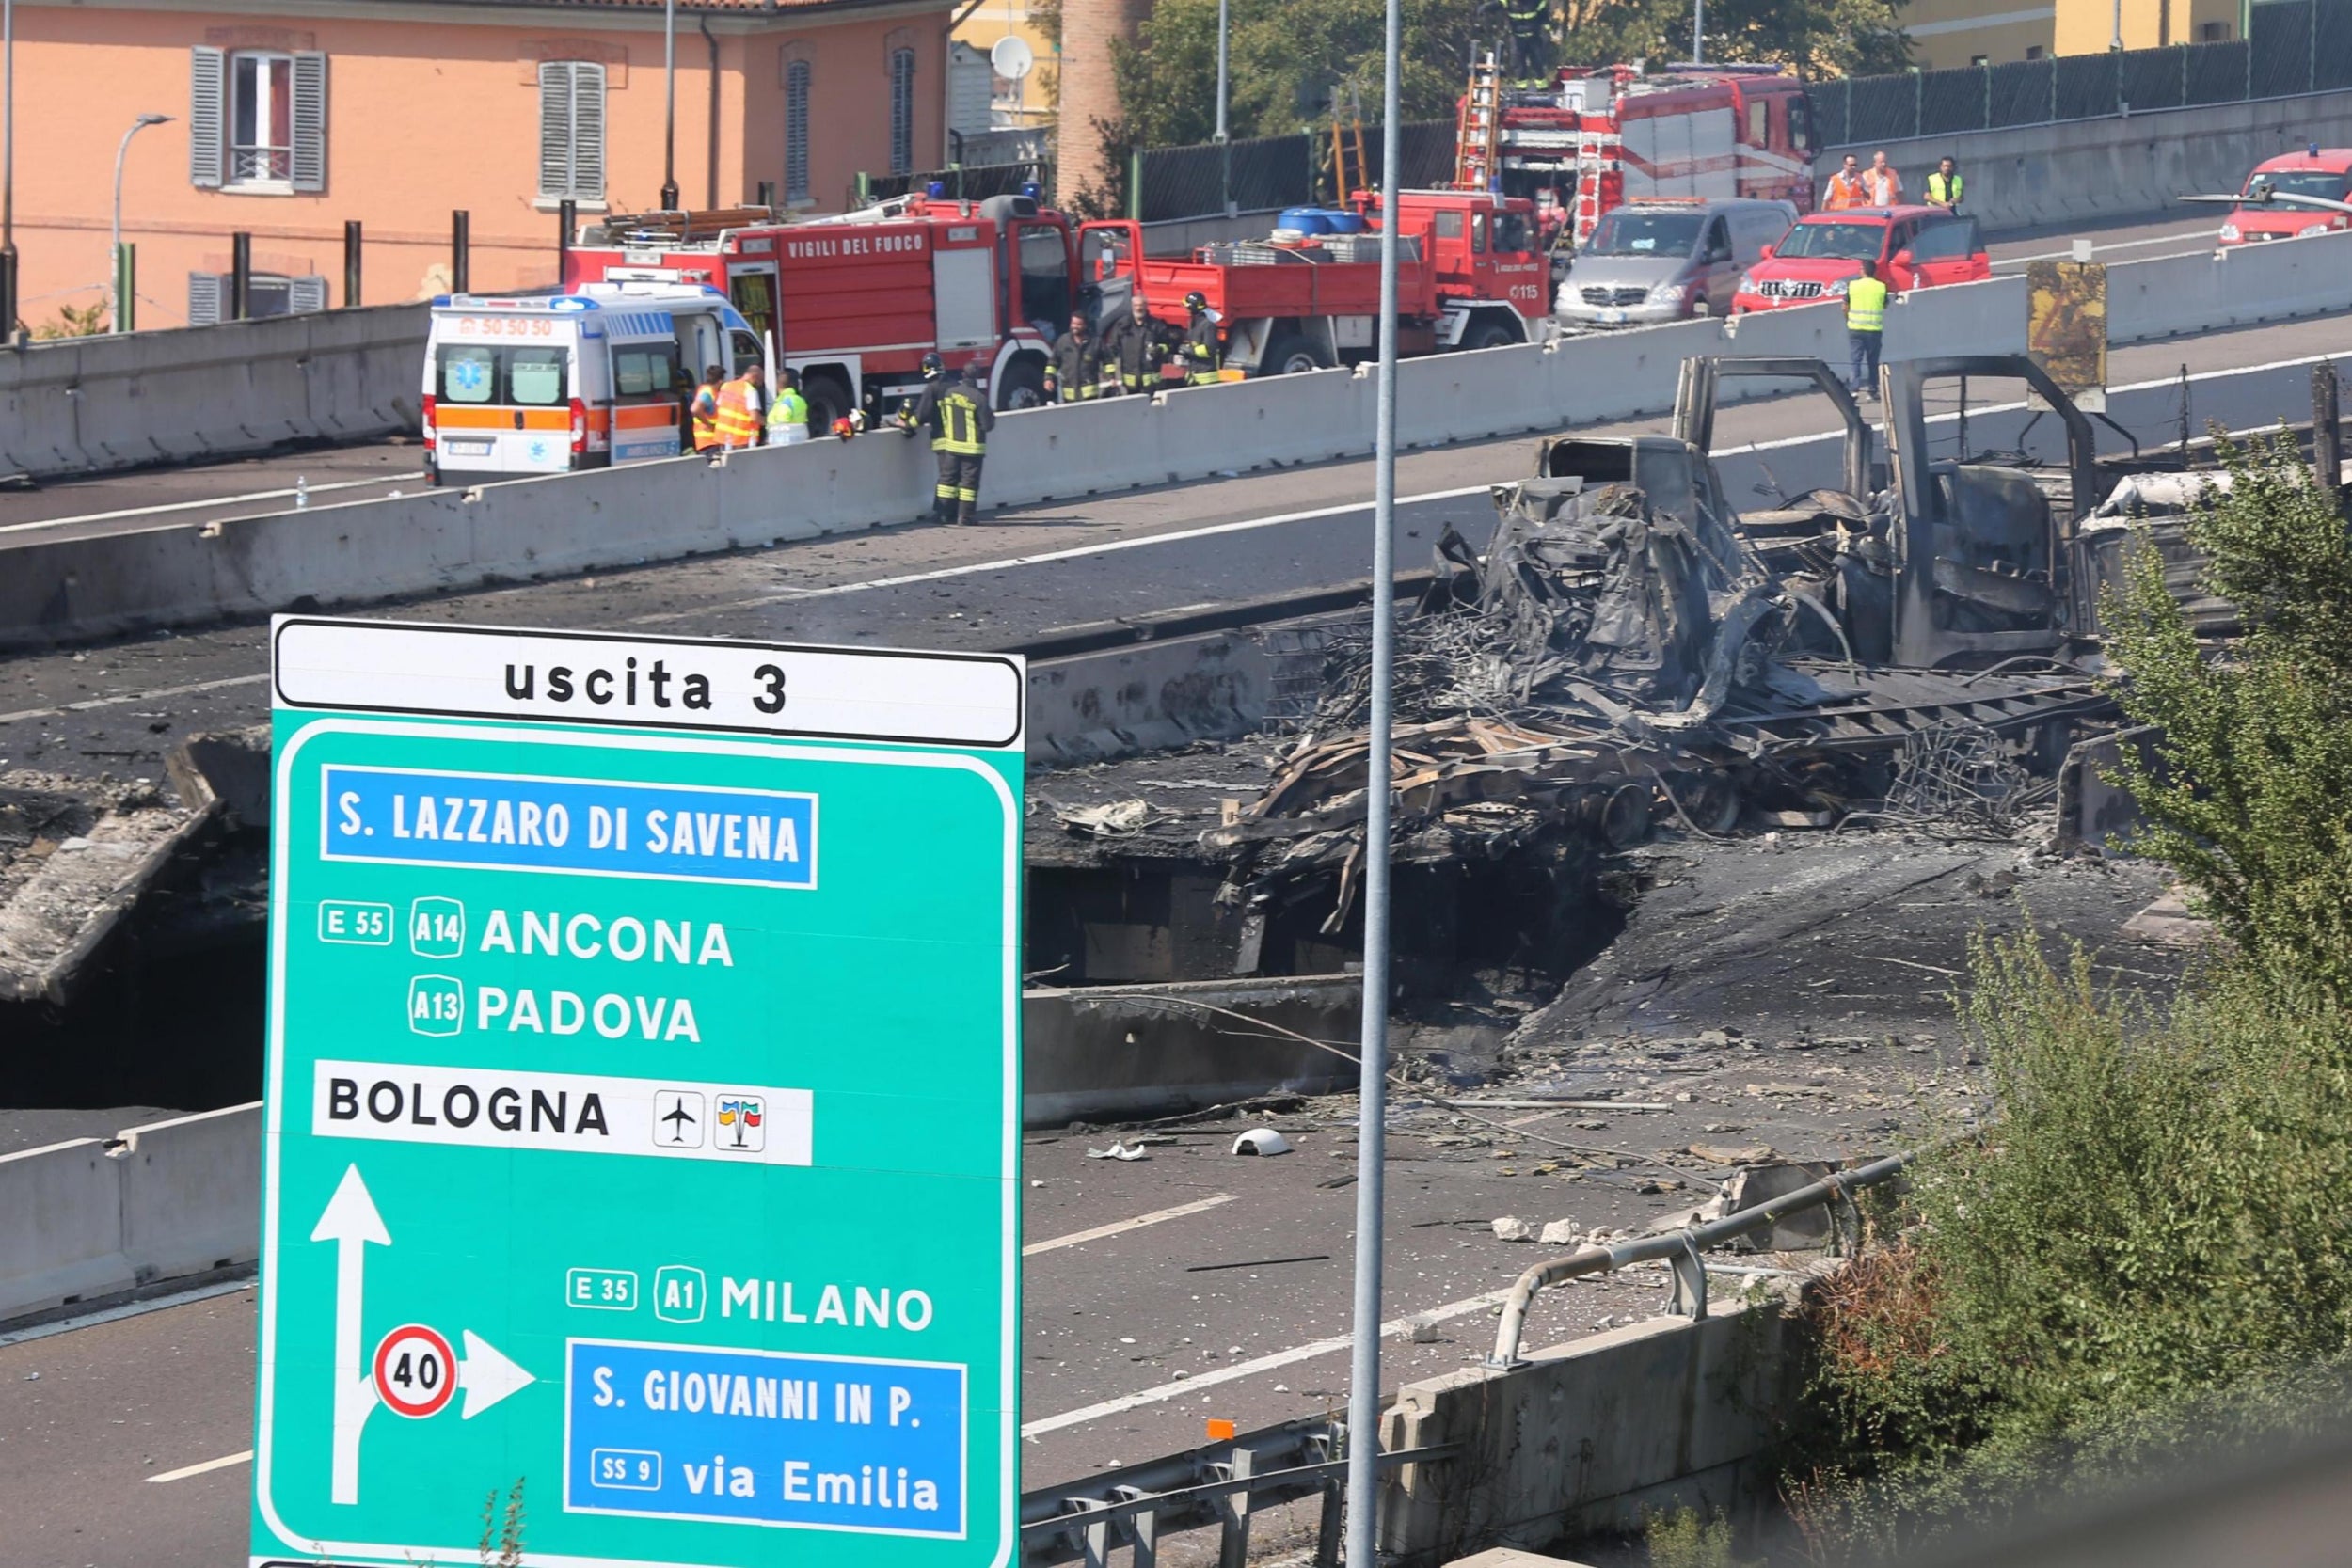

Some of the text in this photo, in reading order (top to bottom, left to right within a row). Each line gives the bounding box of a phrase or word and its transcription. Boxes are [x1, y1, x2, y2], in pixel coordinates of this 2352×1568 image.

[789, 235, 922, 257] VIGILI DEL FUOCO
[1520, 285, 1538, 299] 115
[483, 319, 551, 336] 50 50 50
[505, 657, 785, 713] uscita 3
[340, 792, 798, 862] S. LAZZARO DI SAVENA
[329, 910, 733, 966] E 55 A14 ANCONA
[414, 987, 700, 1042] A13 PADOVA
[330, 1079, 608, 1135] BOLOGNA
[577, 1277, 932, 1331] E 35 A1 MILANO
[394, 1354, 437, 1389] 40
[594, 1367, 919, 1427] S. GIOVANNI IN P.
[603, 1455, 938, 1510] SS 9 via Emilia
